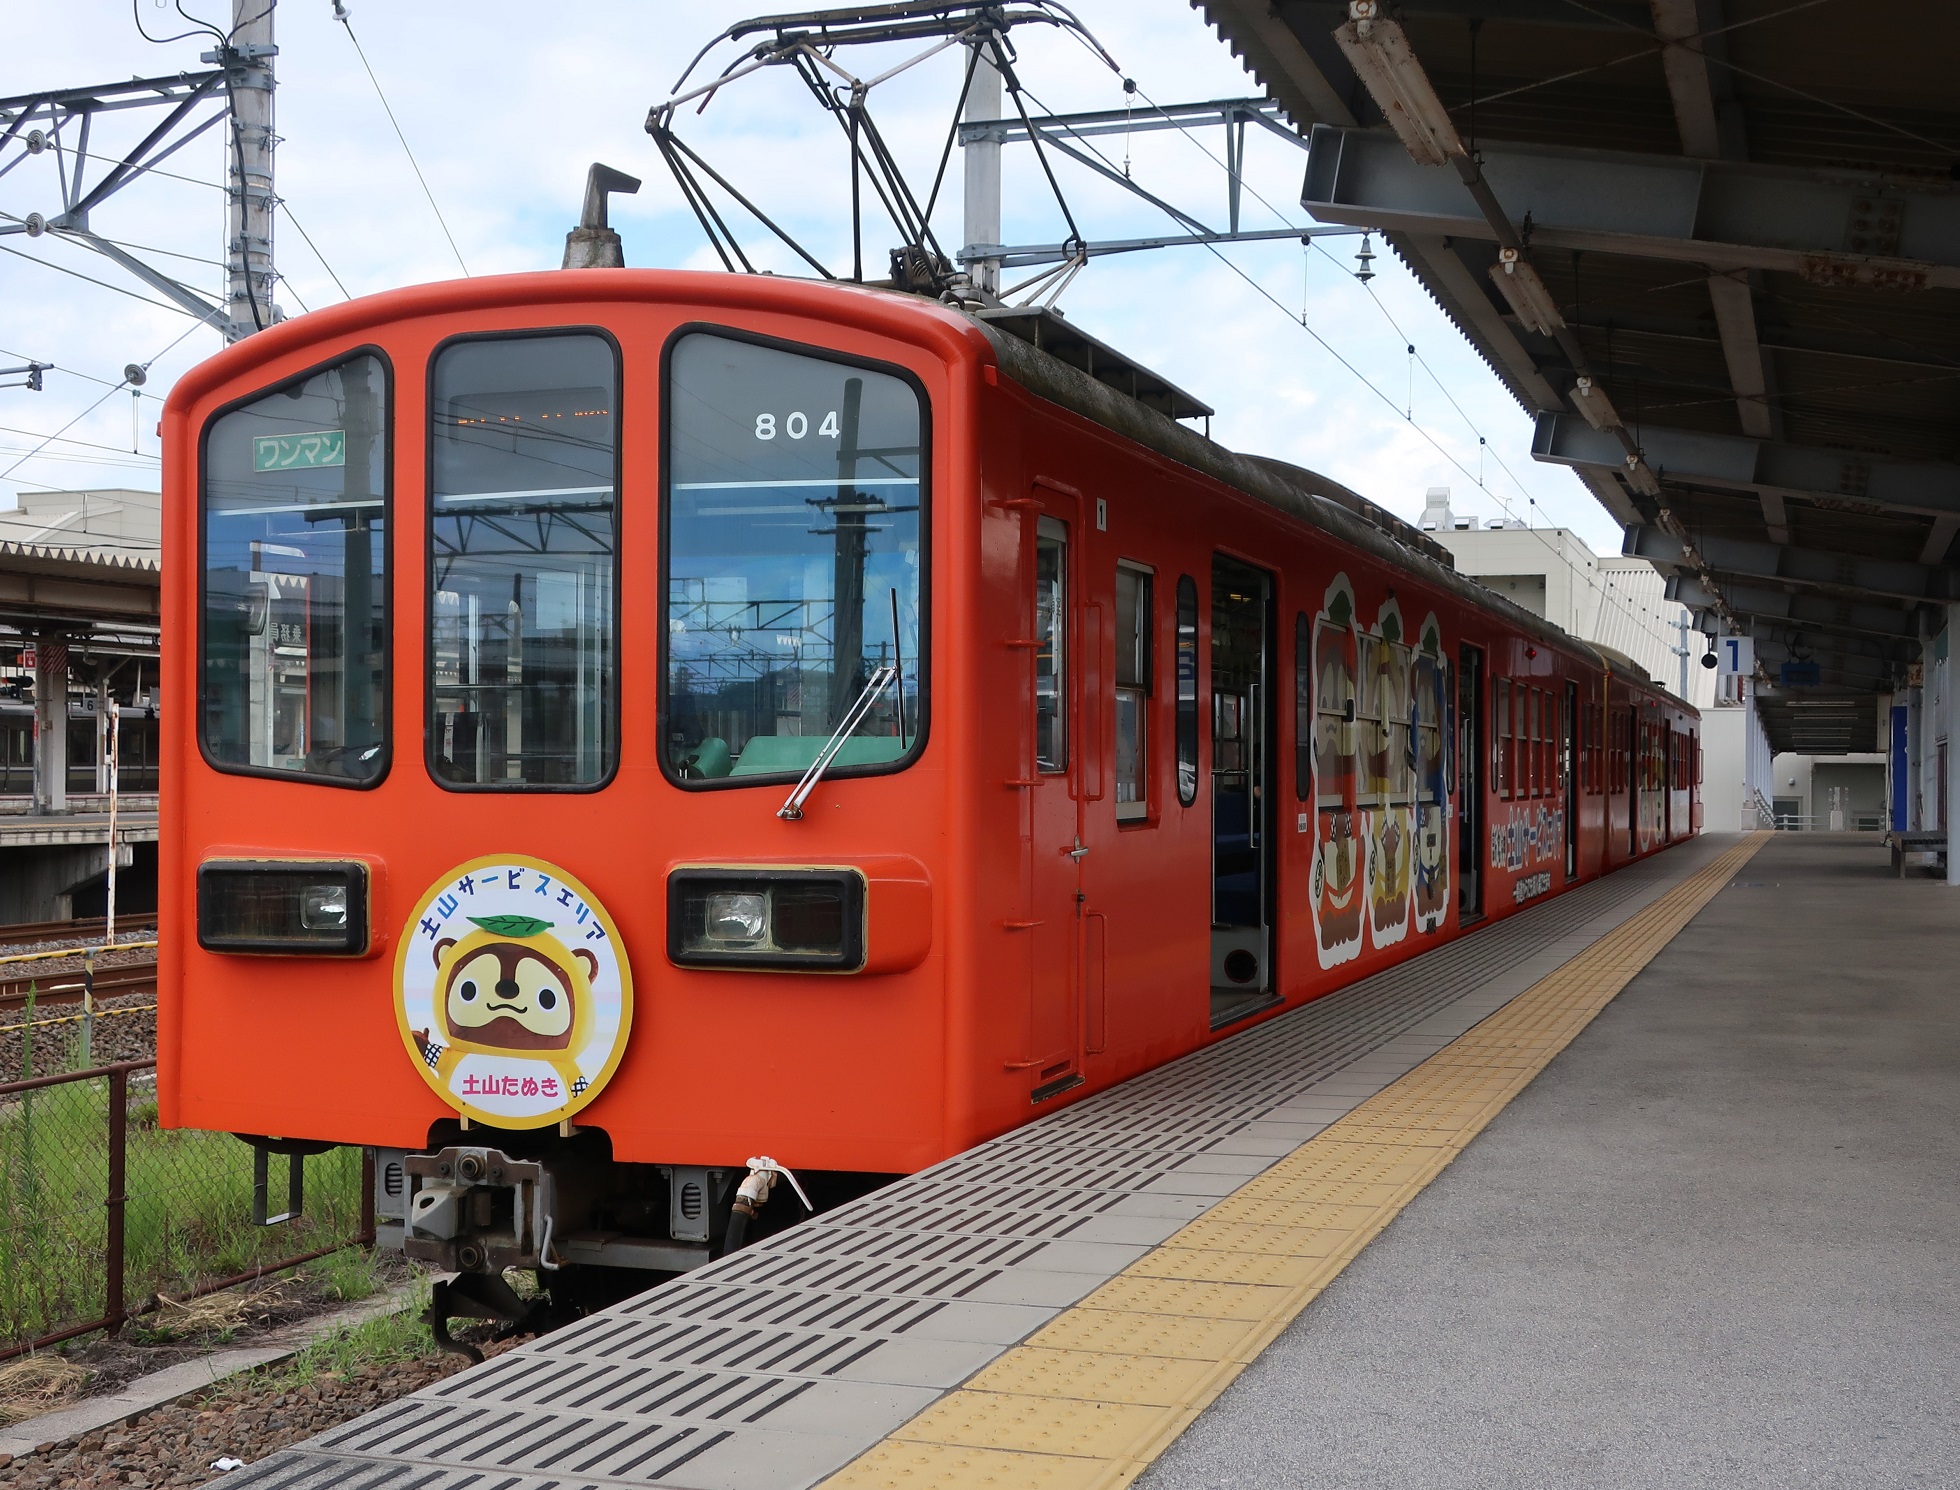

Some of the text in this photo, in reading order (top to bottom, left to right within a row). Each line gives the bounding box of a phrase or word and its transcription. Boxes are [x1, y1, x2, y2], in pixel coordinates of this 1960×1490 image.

[754, 411, 840, 440] 804
[259, 437, 342, 468] ワンマン
[1725, 640, 1739, 672] 1
[86, 700, 94, 711] 6
[420, 867, 606, 941] 土山サービスエリア
[462, 1074, 559, 1098] 土山たぬき
